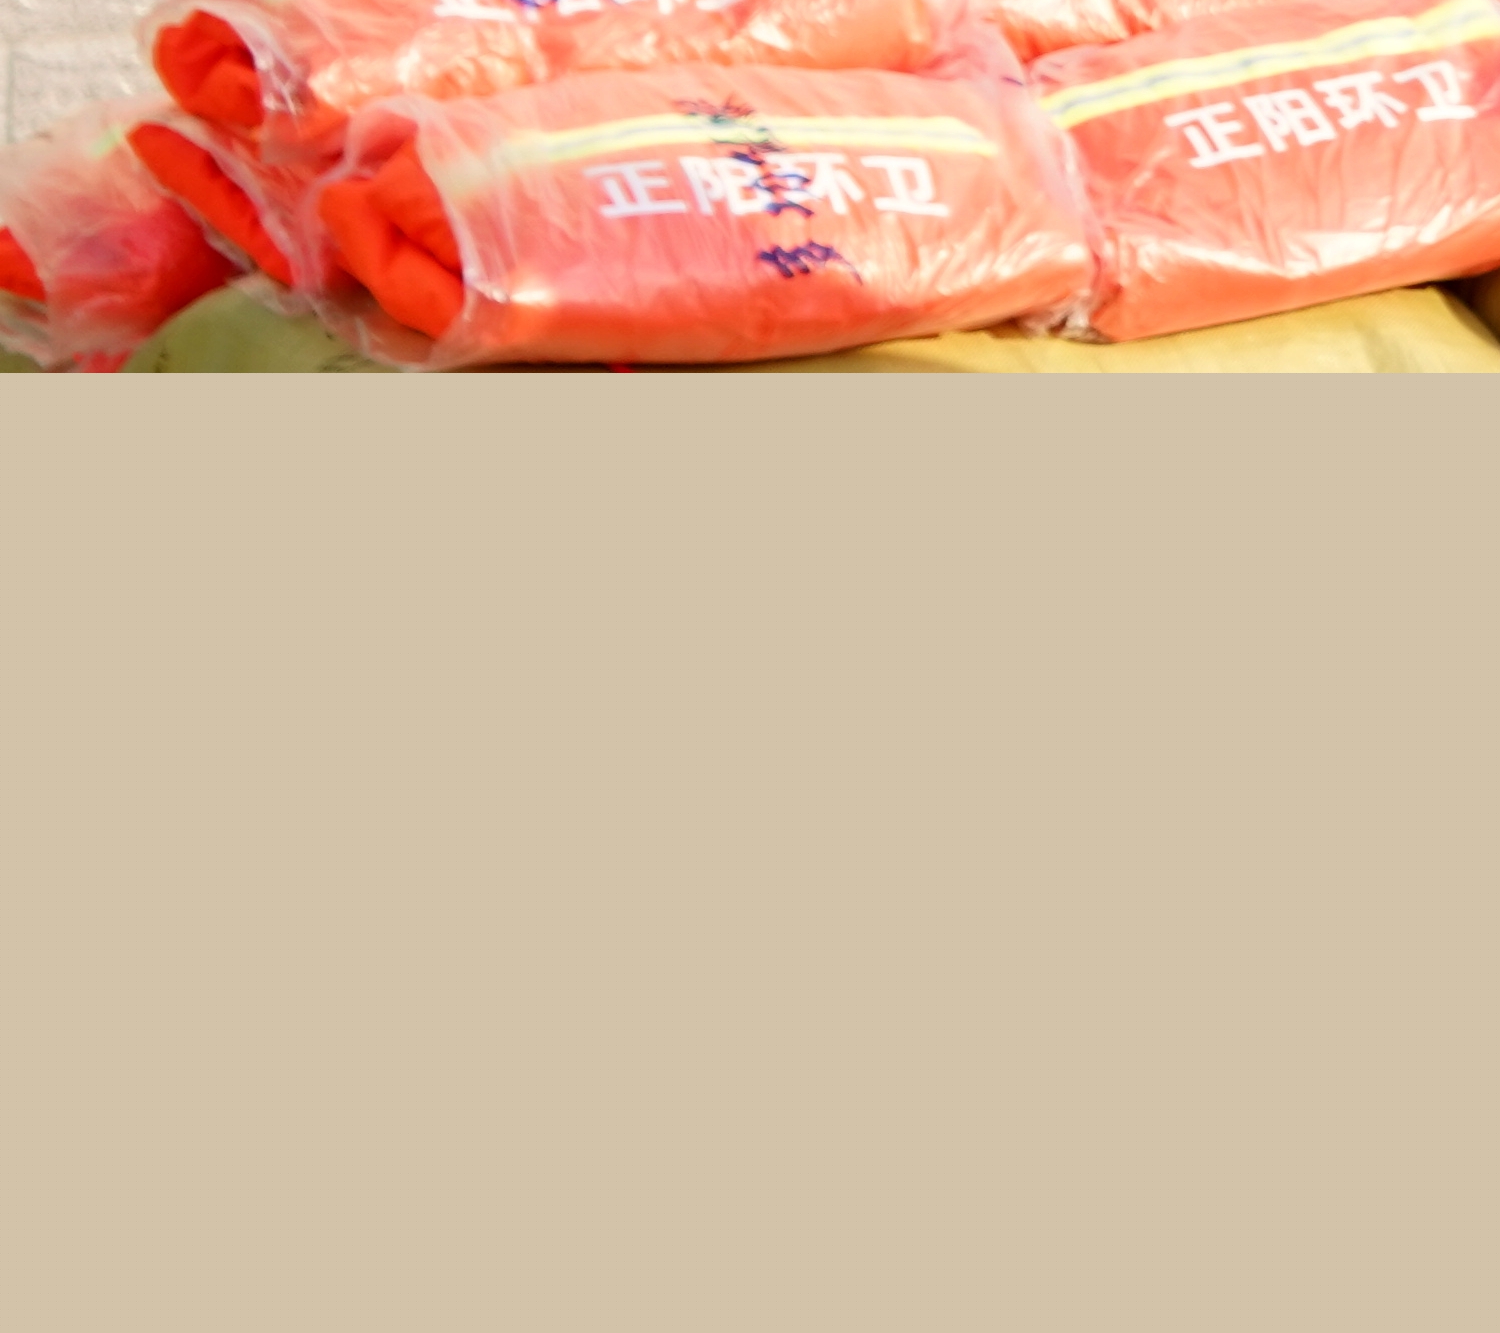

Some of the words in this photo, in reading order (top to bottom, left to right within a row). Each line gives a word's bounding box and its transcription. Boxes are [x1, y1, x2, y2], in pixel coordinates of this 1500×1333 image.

[1163, 59, 1478, 170] 正阳环卫
[583, 151, 950, 220] 正阳环卫
